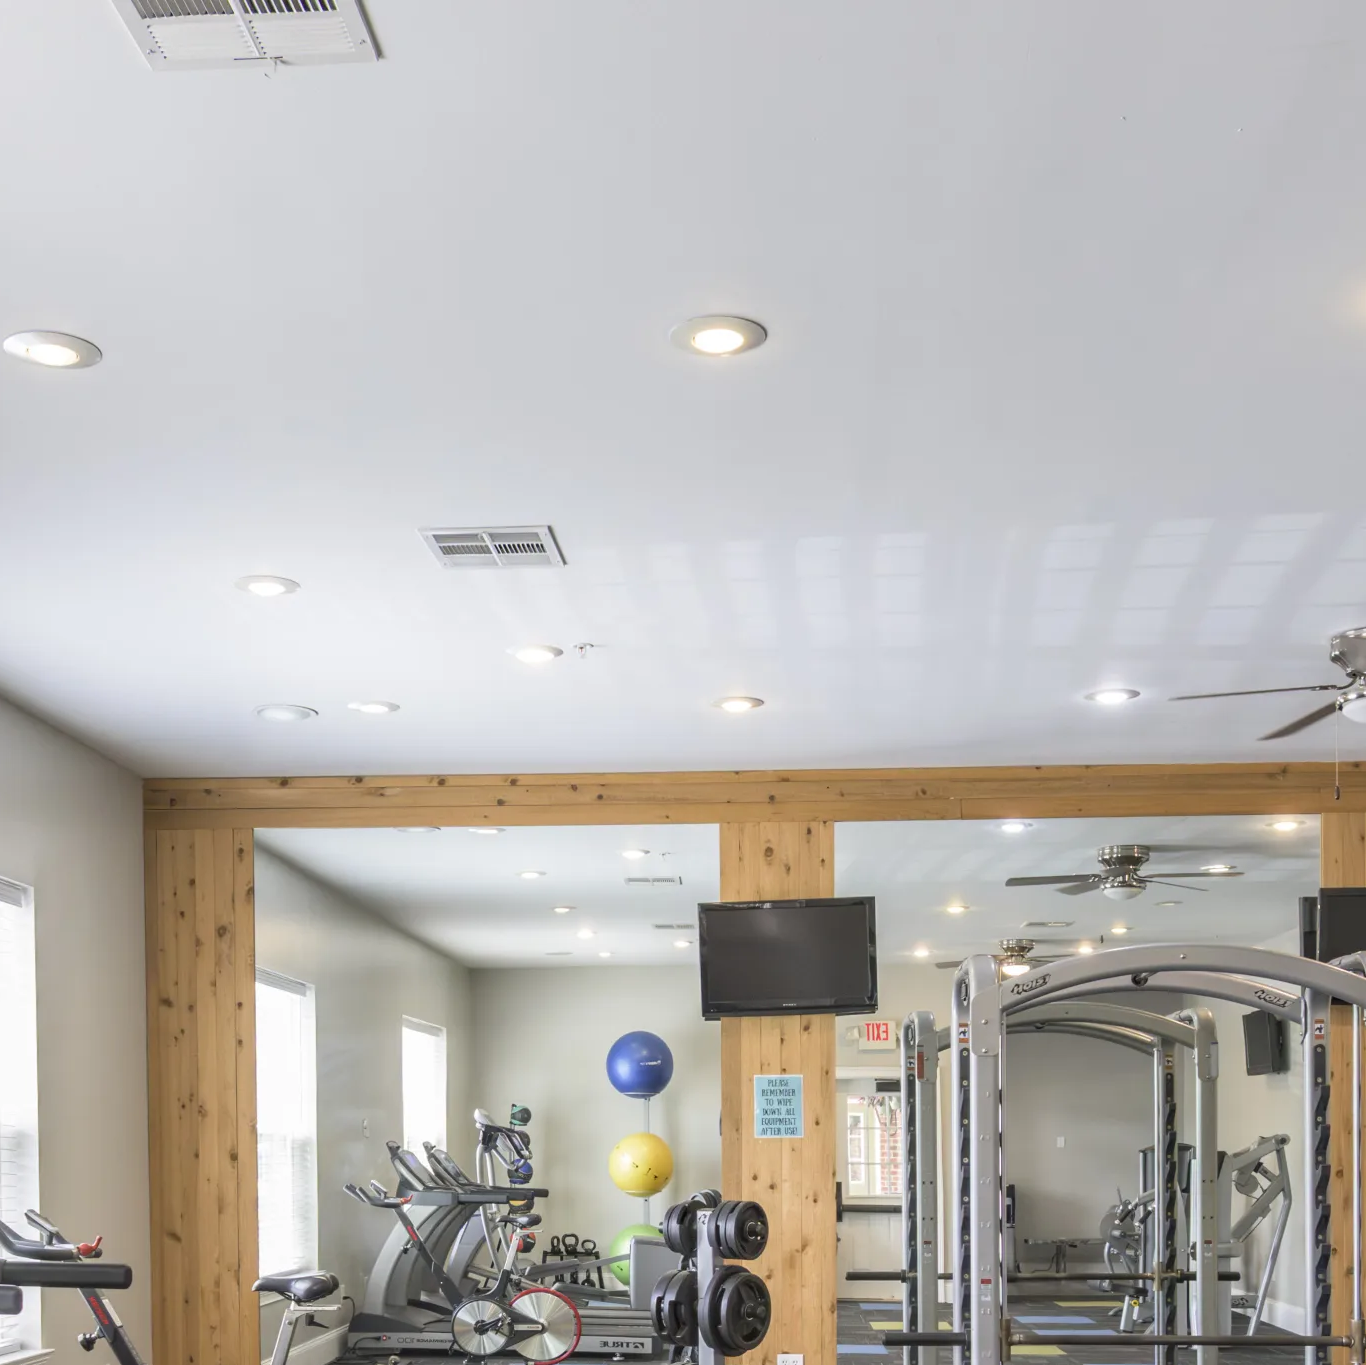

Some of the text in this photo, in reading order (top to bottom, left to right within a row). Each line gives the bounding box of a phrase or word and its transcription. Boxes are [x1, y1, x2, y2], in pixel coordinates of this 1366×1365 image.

[1011, 973, 1051, 995] HOIST
[1254, 989, 1295, 1008] HOIST
[767, 1079, 789, 1087] PLEASE
[761, 1088, 796, 1097] REMEMBER
[764, 1098, 793, 1106] TO WIPE
[762, 1107, 795, 1116] DOWN ALL
[761, 1117, 797, 1126] EQUIPMENT
[761, 1126, 798, 1136] AFTER USE!
